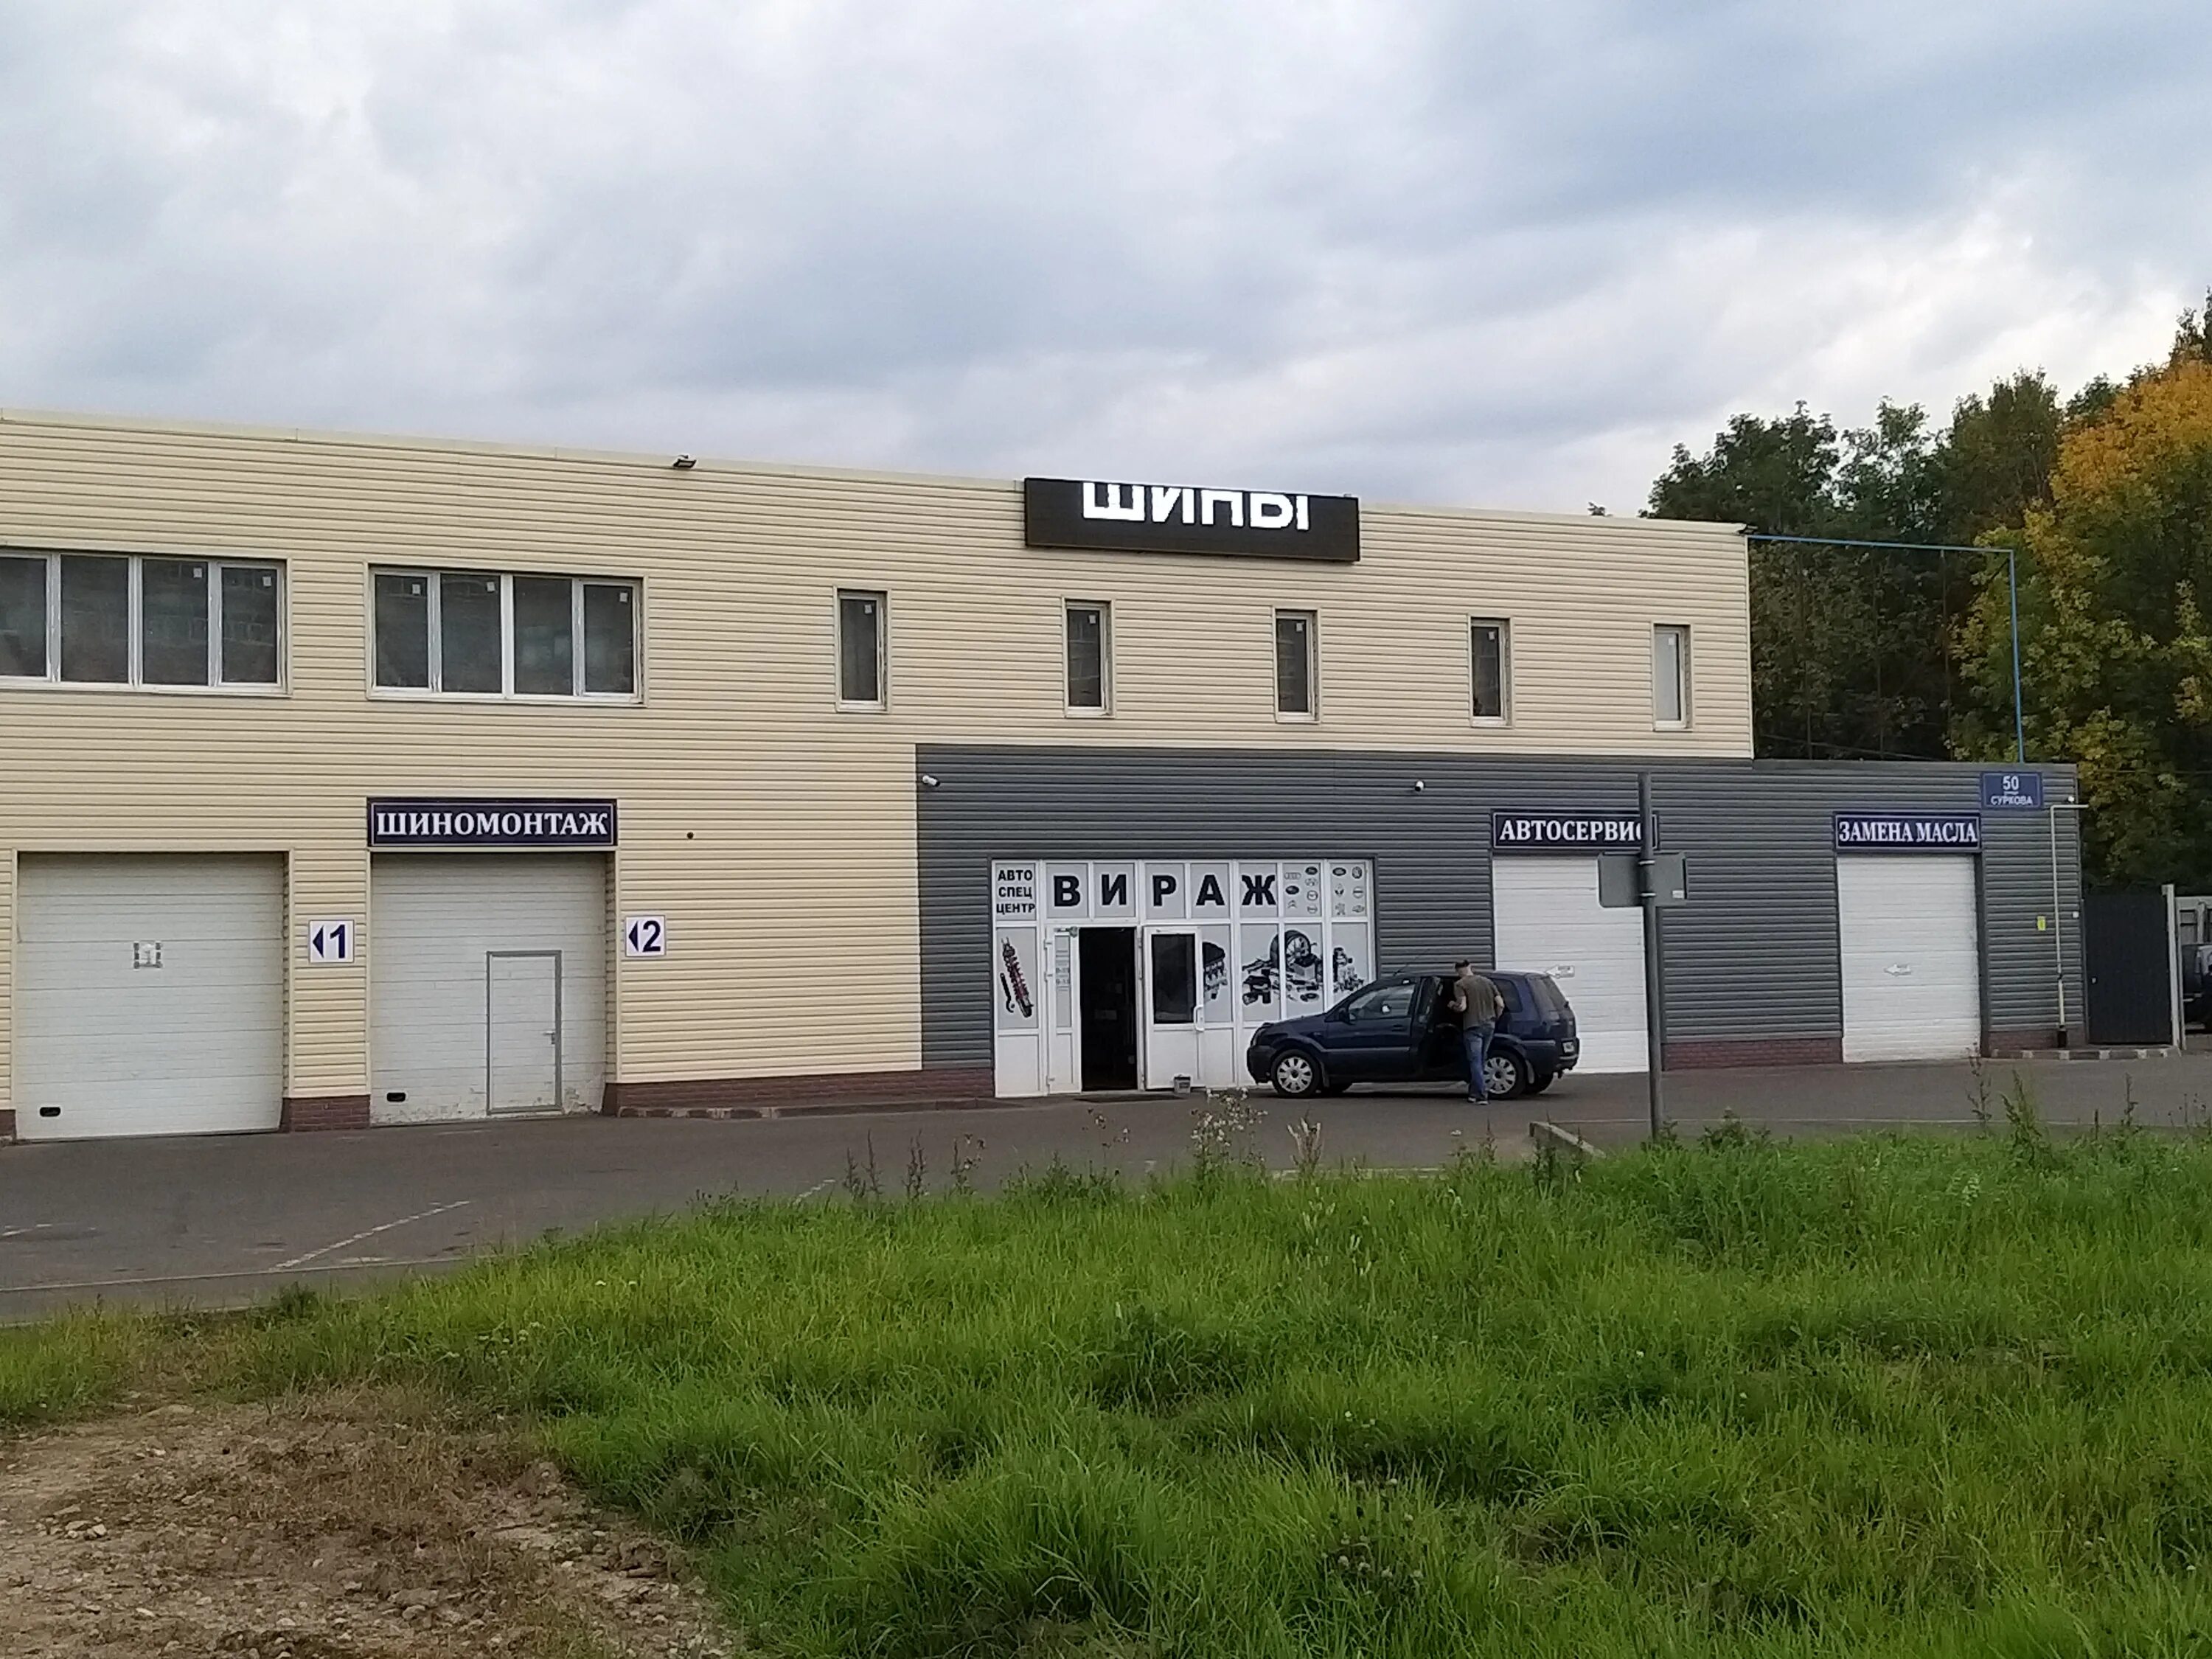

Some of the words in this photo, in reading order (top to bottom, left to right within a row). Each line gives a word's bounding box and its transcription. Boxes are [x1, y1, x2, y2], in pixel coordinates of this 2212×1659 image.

[2003, 776, 2019, 790] 50
[1991, 796, 2033, 805] СУРКОВА
[376, 811, 608, 836] ШИНОМОНТАЖ
[1839, 821, 1913, 842] ЗАМЕНА
[1916, 822, 1978, 843] МАСЛА
[998, 869, 1032, 881] АВТО
[998, 886, 1032, 900] СПЕЦ
[1054, 874, 1277, 908] ВИРАЖ
[996, 903, 1036, 915] ЦЕНТР
[330, 924, 345, 959] 1
[642, 919, 662, 953] 2
